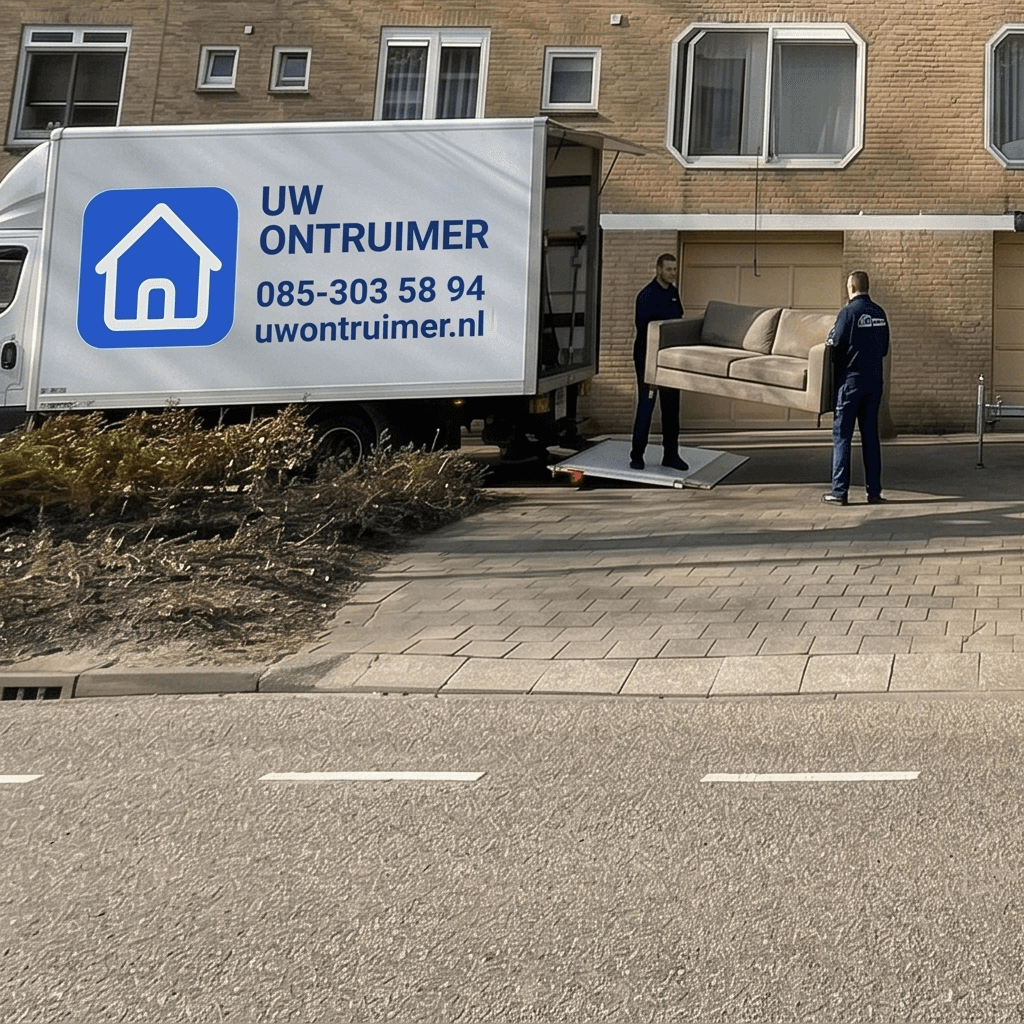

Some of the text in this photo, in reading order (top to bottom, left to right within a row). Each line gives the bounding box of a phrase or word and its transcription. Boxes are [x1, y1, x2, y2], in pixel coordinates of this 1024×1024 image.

[261, 184, 324, 217] UW
[259, 219, 490, 256] ONTRUIMER
[256, 274, 486, 308] 085-303 58 94
[255, 309, 485, 345] uwontruimer.nl
